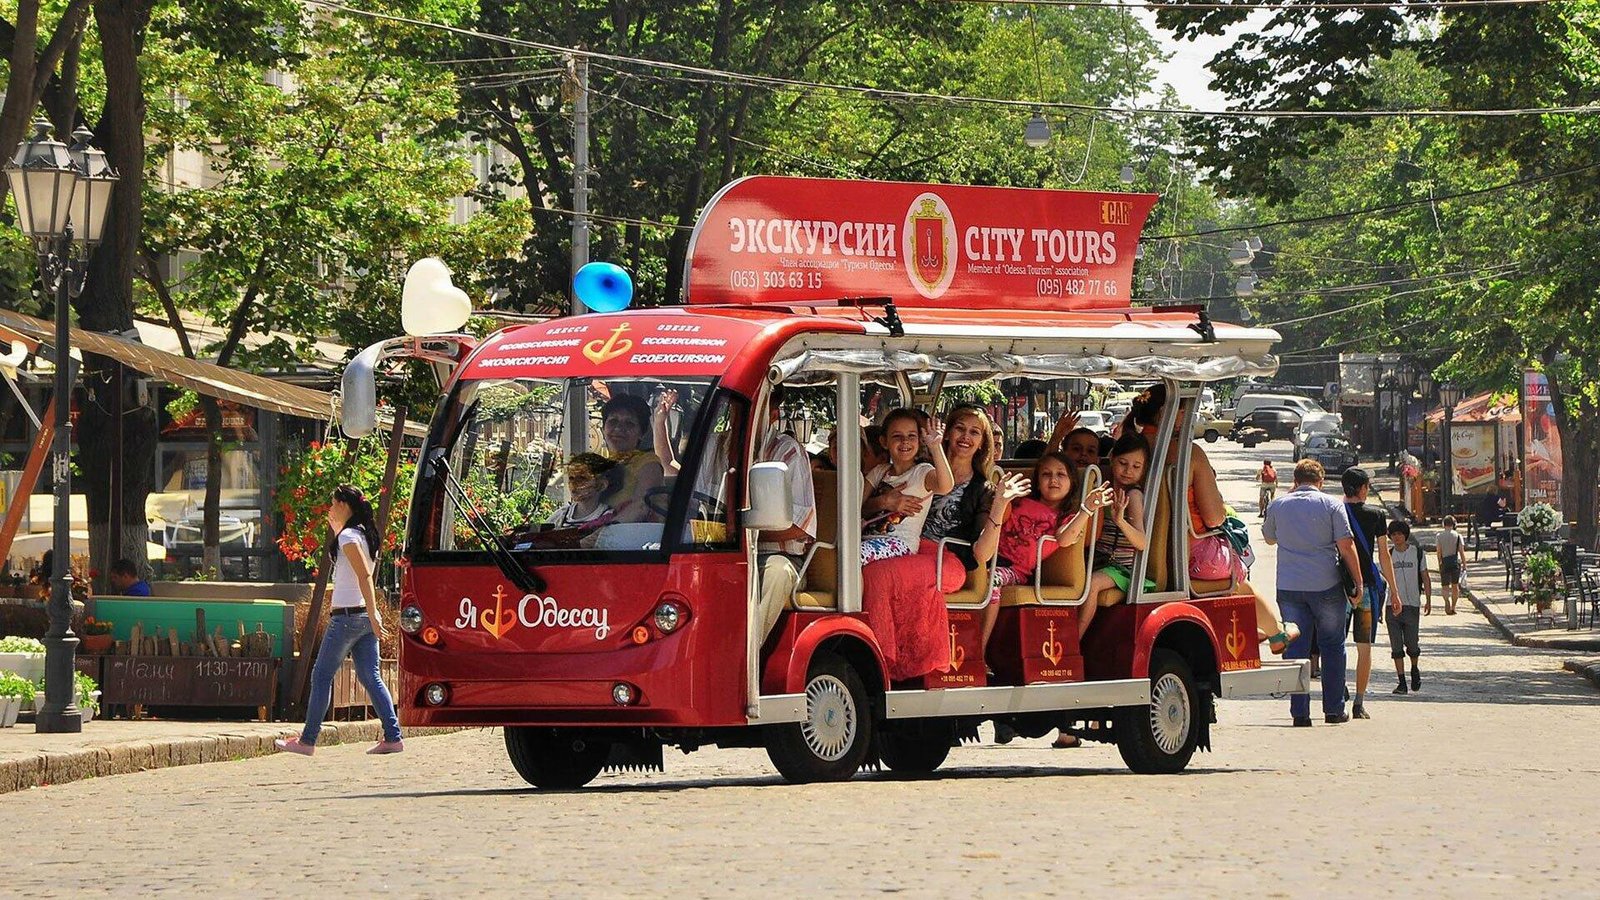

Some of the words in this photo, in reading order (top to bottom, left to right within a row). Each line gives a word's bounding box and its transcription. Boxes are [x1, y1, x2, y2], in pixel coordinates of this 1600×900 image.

[1108, 202, 1129, 224] CAR
[729, 217, 897, 257] ЭКСКУРСИИ
[964, 226, 1025, 262] CITY
[1031, 229, 1117, 265] TOURS
[780, 257, 797, 268] Член
[967, 263, 993, 274] Member
[994, 264, 1001, 274] of
[1055, 266, 1089, 276] association
[730, 270, 760, 291] (063)
[763, 271, 786, 288] 303
[789, 272, 804, 288] 63
[807, 272, 822, 289] 15
[1036, 279, 1062, 297] (095)
[1065, 279, 1085, 295] 482
[1088, 280, 1100, 295] 77
[1104, 280, 1117, 295] 66
[478, 355, 571, 368] ЭКОЭКСКУРСИЯ
[629, 354, 727, 364] ECOEXCURSION
[454, 597, 477, 629] Я
[518, 593, 611, 640] Одессу
